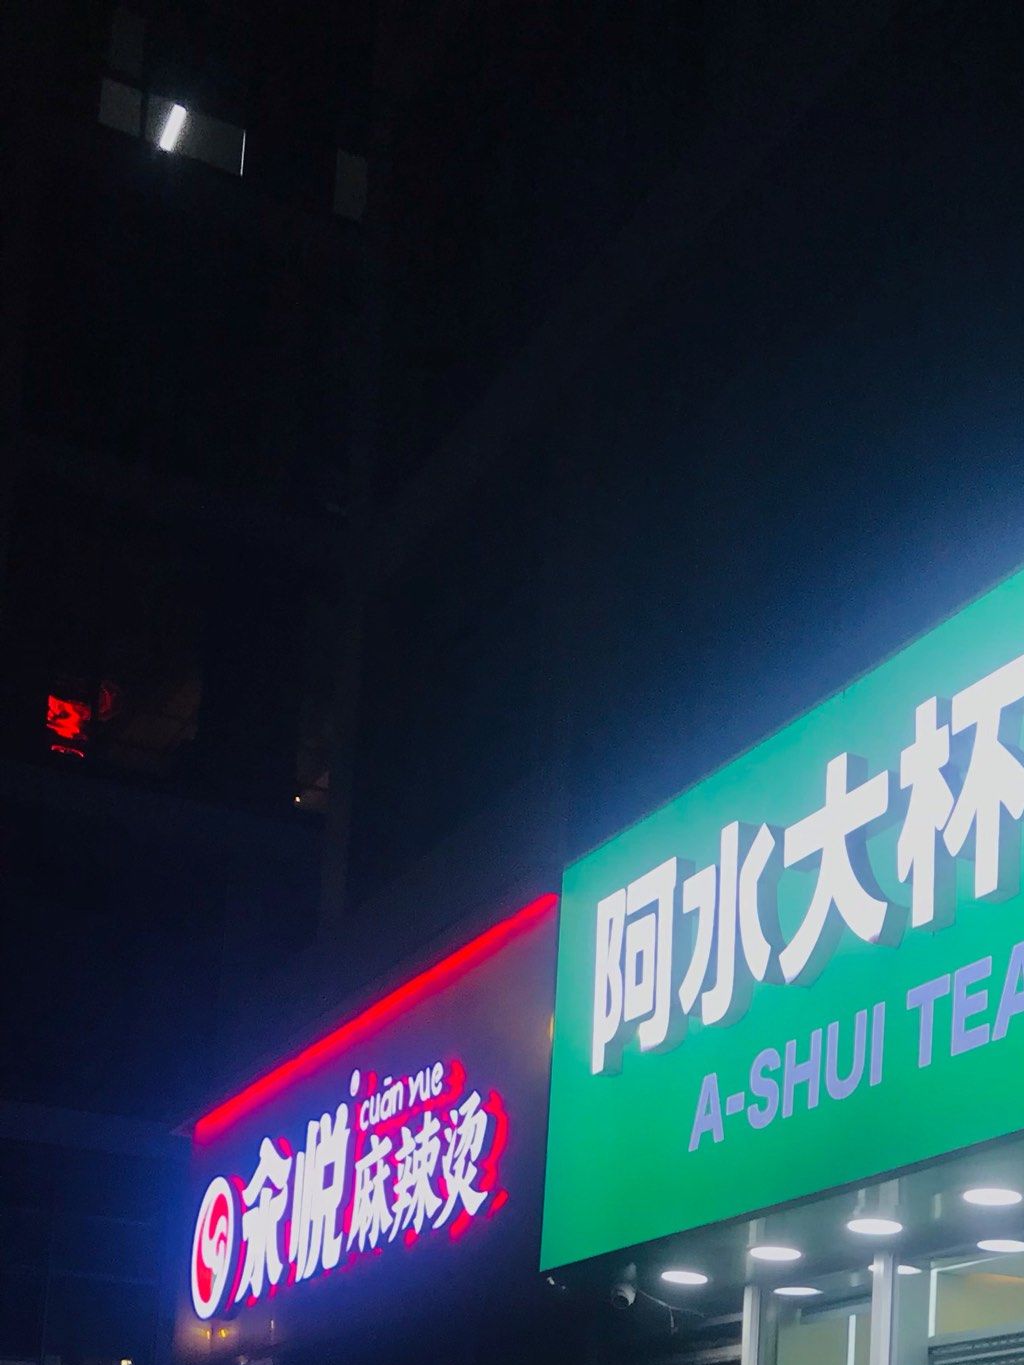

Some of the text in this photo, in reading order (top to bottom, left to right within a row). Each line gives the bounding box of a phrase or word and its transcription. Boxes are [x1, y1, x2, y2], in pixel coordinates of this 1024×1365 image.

[689, 1001, 886, 1152] A-SHUI
[346, 1090, 488, 1252] 麻辣烫
